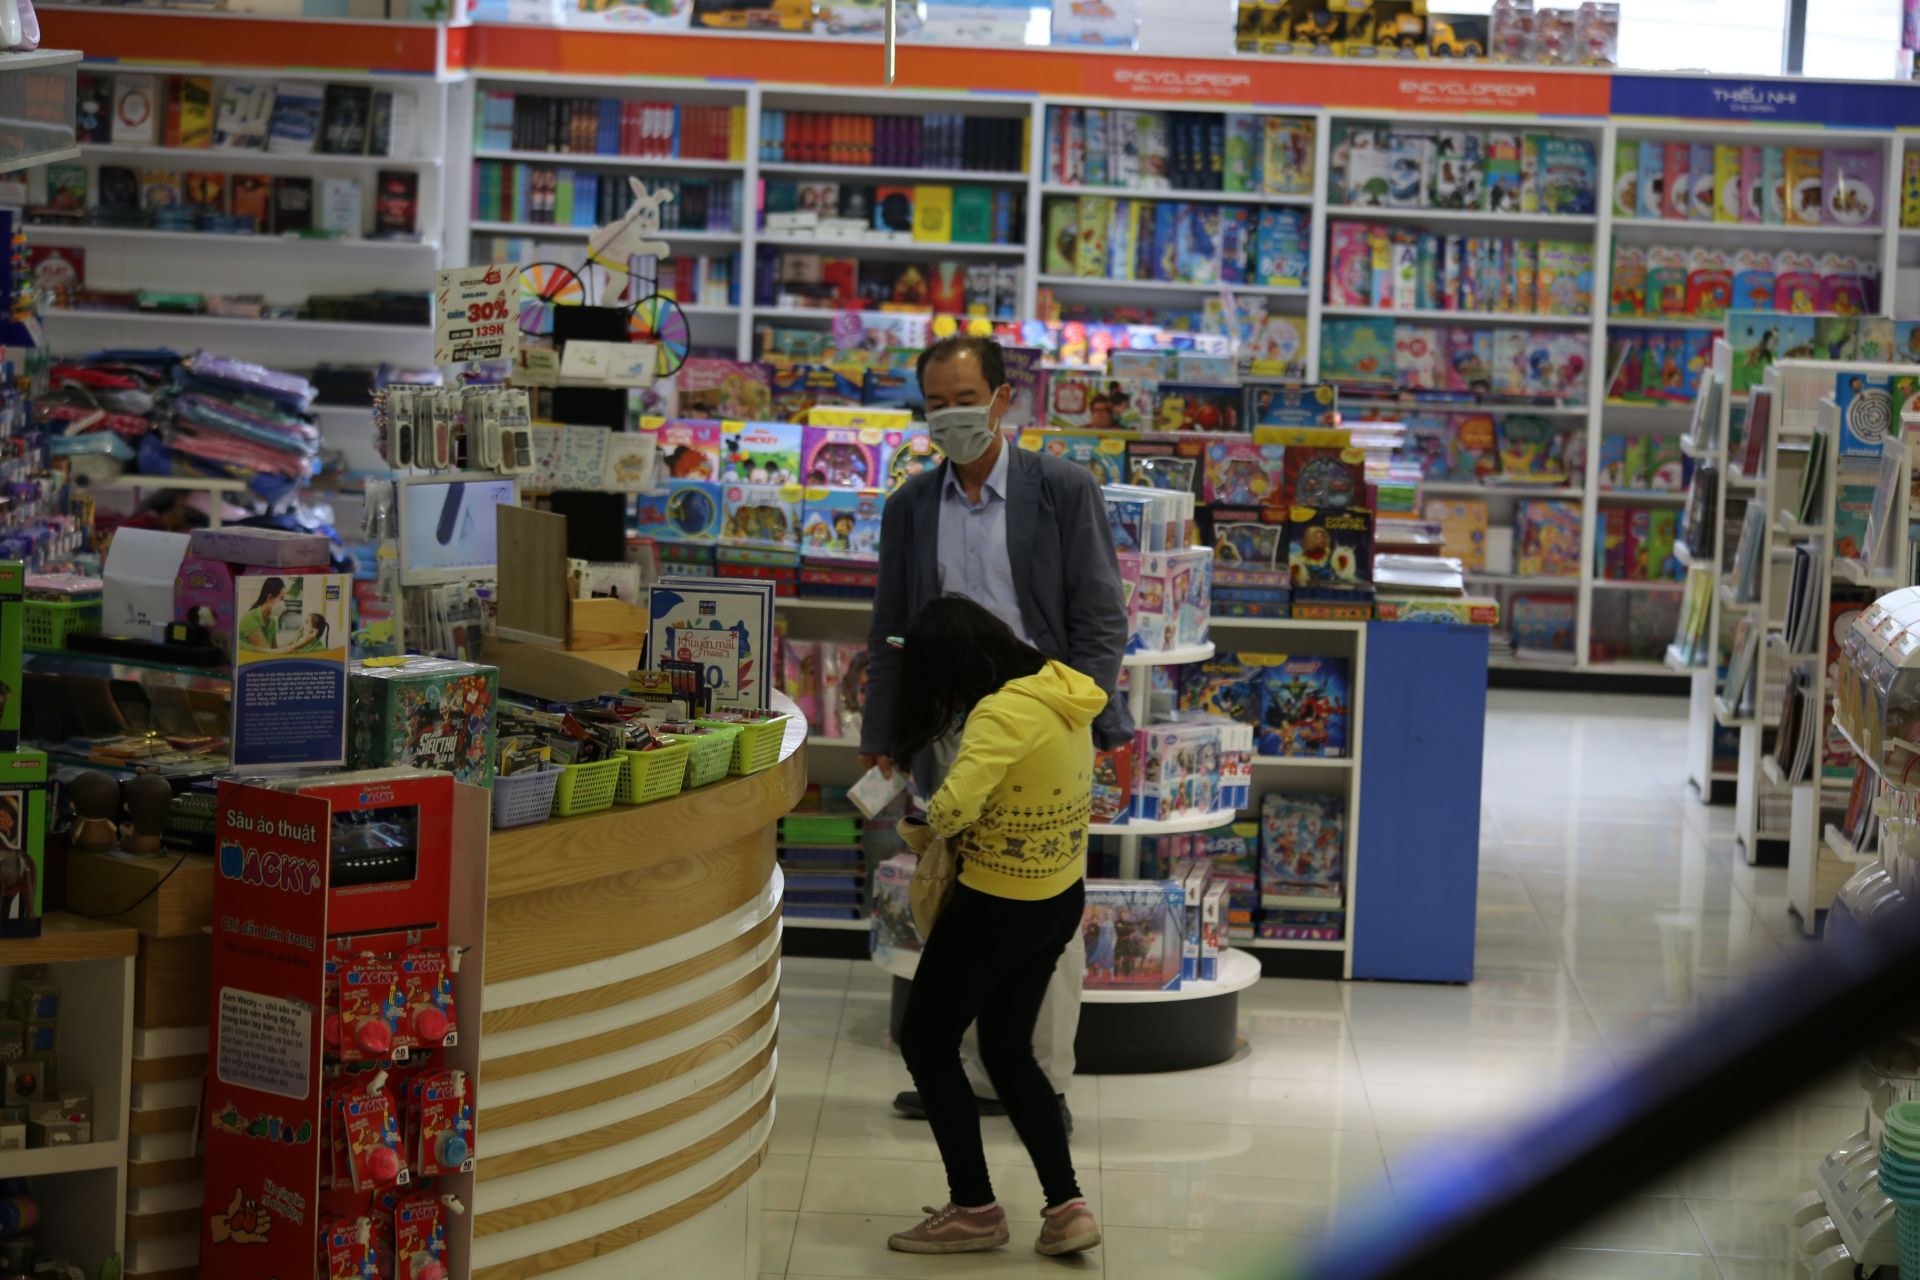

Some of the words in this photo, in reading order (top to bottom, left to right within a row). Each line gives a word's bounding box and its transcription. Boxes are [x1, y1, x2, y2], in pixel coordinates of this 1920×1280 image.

[1114, 70, 1250, 86] ENCYCLOPEDIA
[1399, 80, 1537, 97] ENCYCLOPEDIA
[1767, 90, 1797, 105] NHI
[468, 300, 509, 323] 30%
[226, 808, 254, 831] Sâu
[257, 815, 274, 835] ảo
[278, 819, 317, 845] thuật
[219, 838, 320, 895] WACKY
[222, 916, 240, 933] Chỉ
[263, 925, 284, 942] bên
[286, 929, 317, 952] trong
